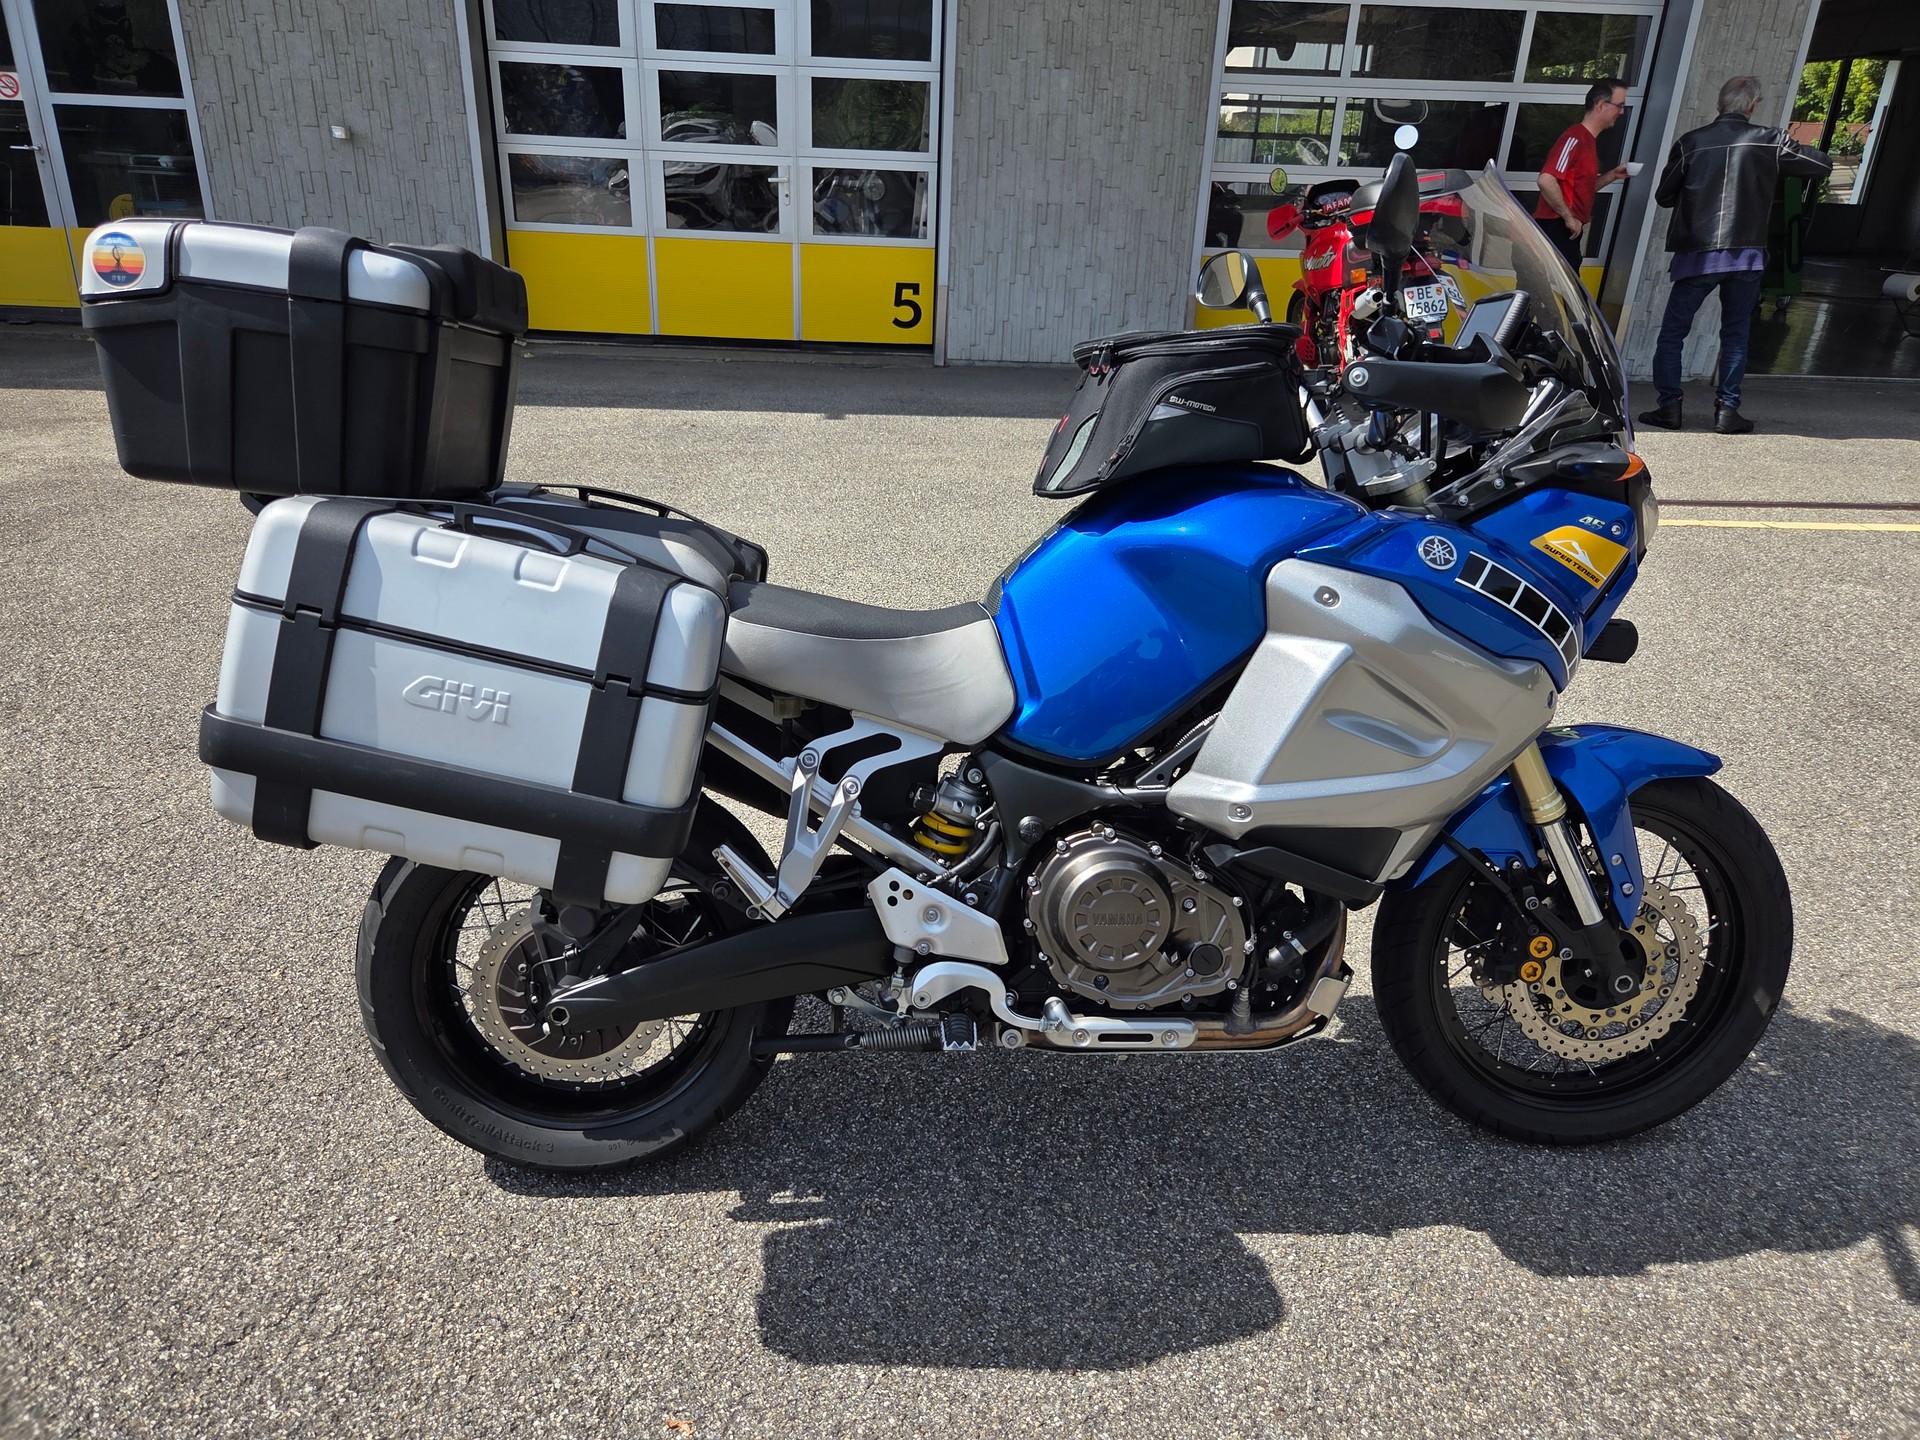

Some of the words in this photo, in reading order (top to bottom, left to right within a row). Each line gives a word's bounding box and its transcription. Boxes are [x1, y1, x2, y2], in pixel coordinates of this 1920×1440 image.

[1417, 286, 1433, 300] BE
[892, 282, 922, 329] 5
[1409, 300, 1446, 316] 75862
[1169, 395, 1217, 412] SW-MOTECH
[1543, 543, 1573, 564] SUPER
[1572, 561, 1601, 584] TENERE
[402, 675, 511, 727] GIVI
[1092, 912, 1144, 927] YAMAHA
